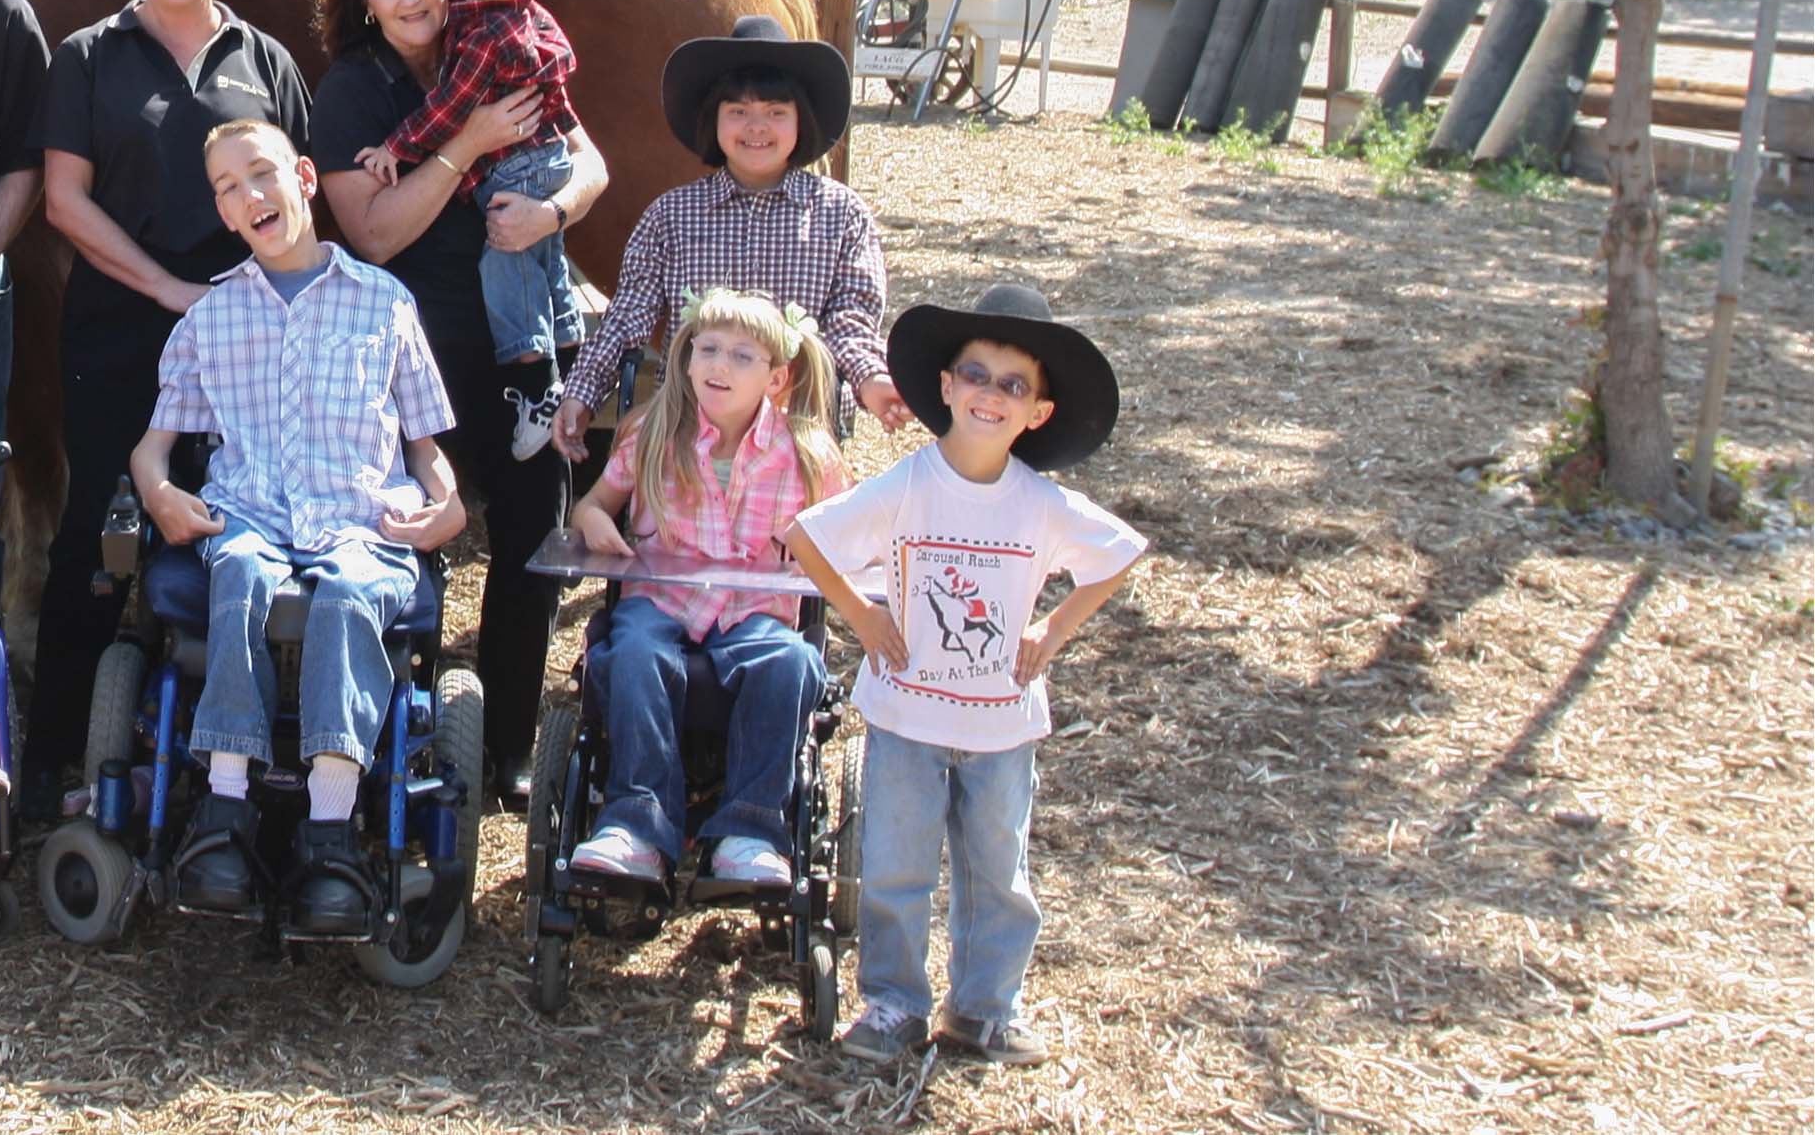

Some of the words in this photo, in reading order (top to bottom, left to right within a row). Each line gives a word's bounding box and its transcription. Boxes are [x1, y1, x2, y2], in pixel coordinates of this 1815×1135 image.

[916, 548, 965, 565] Carousel
[918, 669, 943, 682] Day
[948, 667, 965, 680] At
